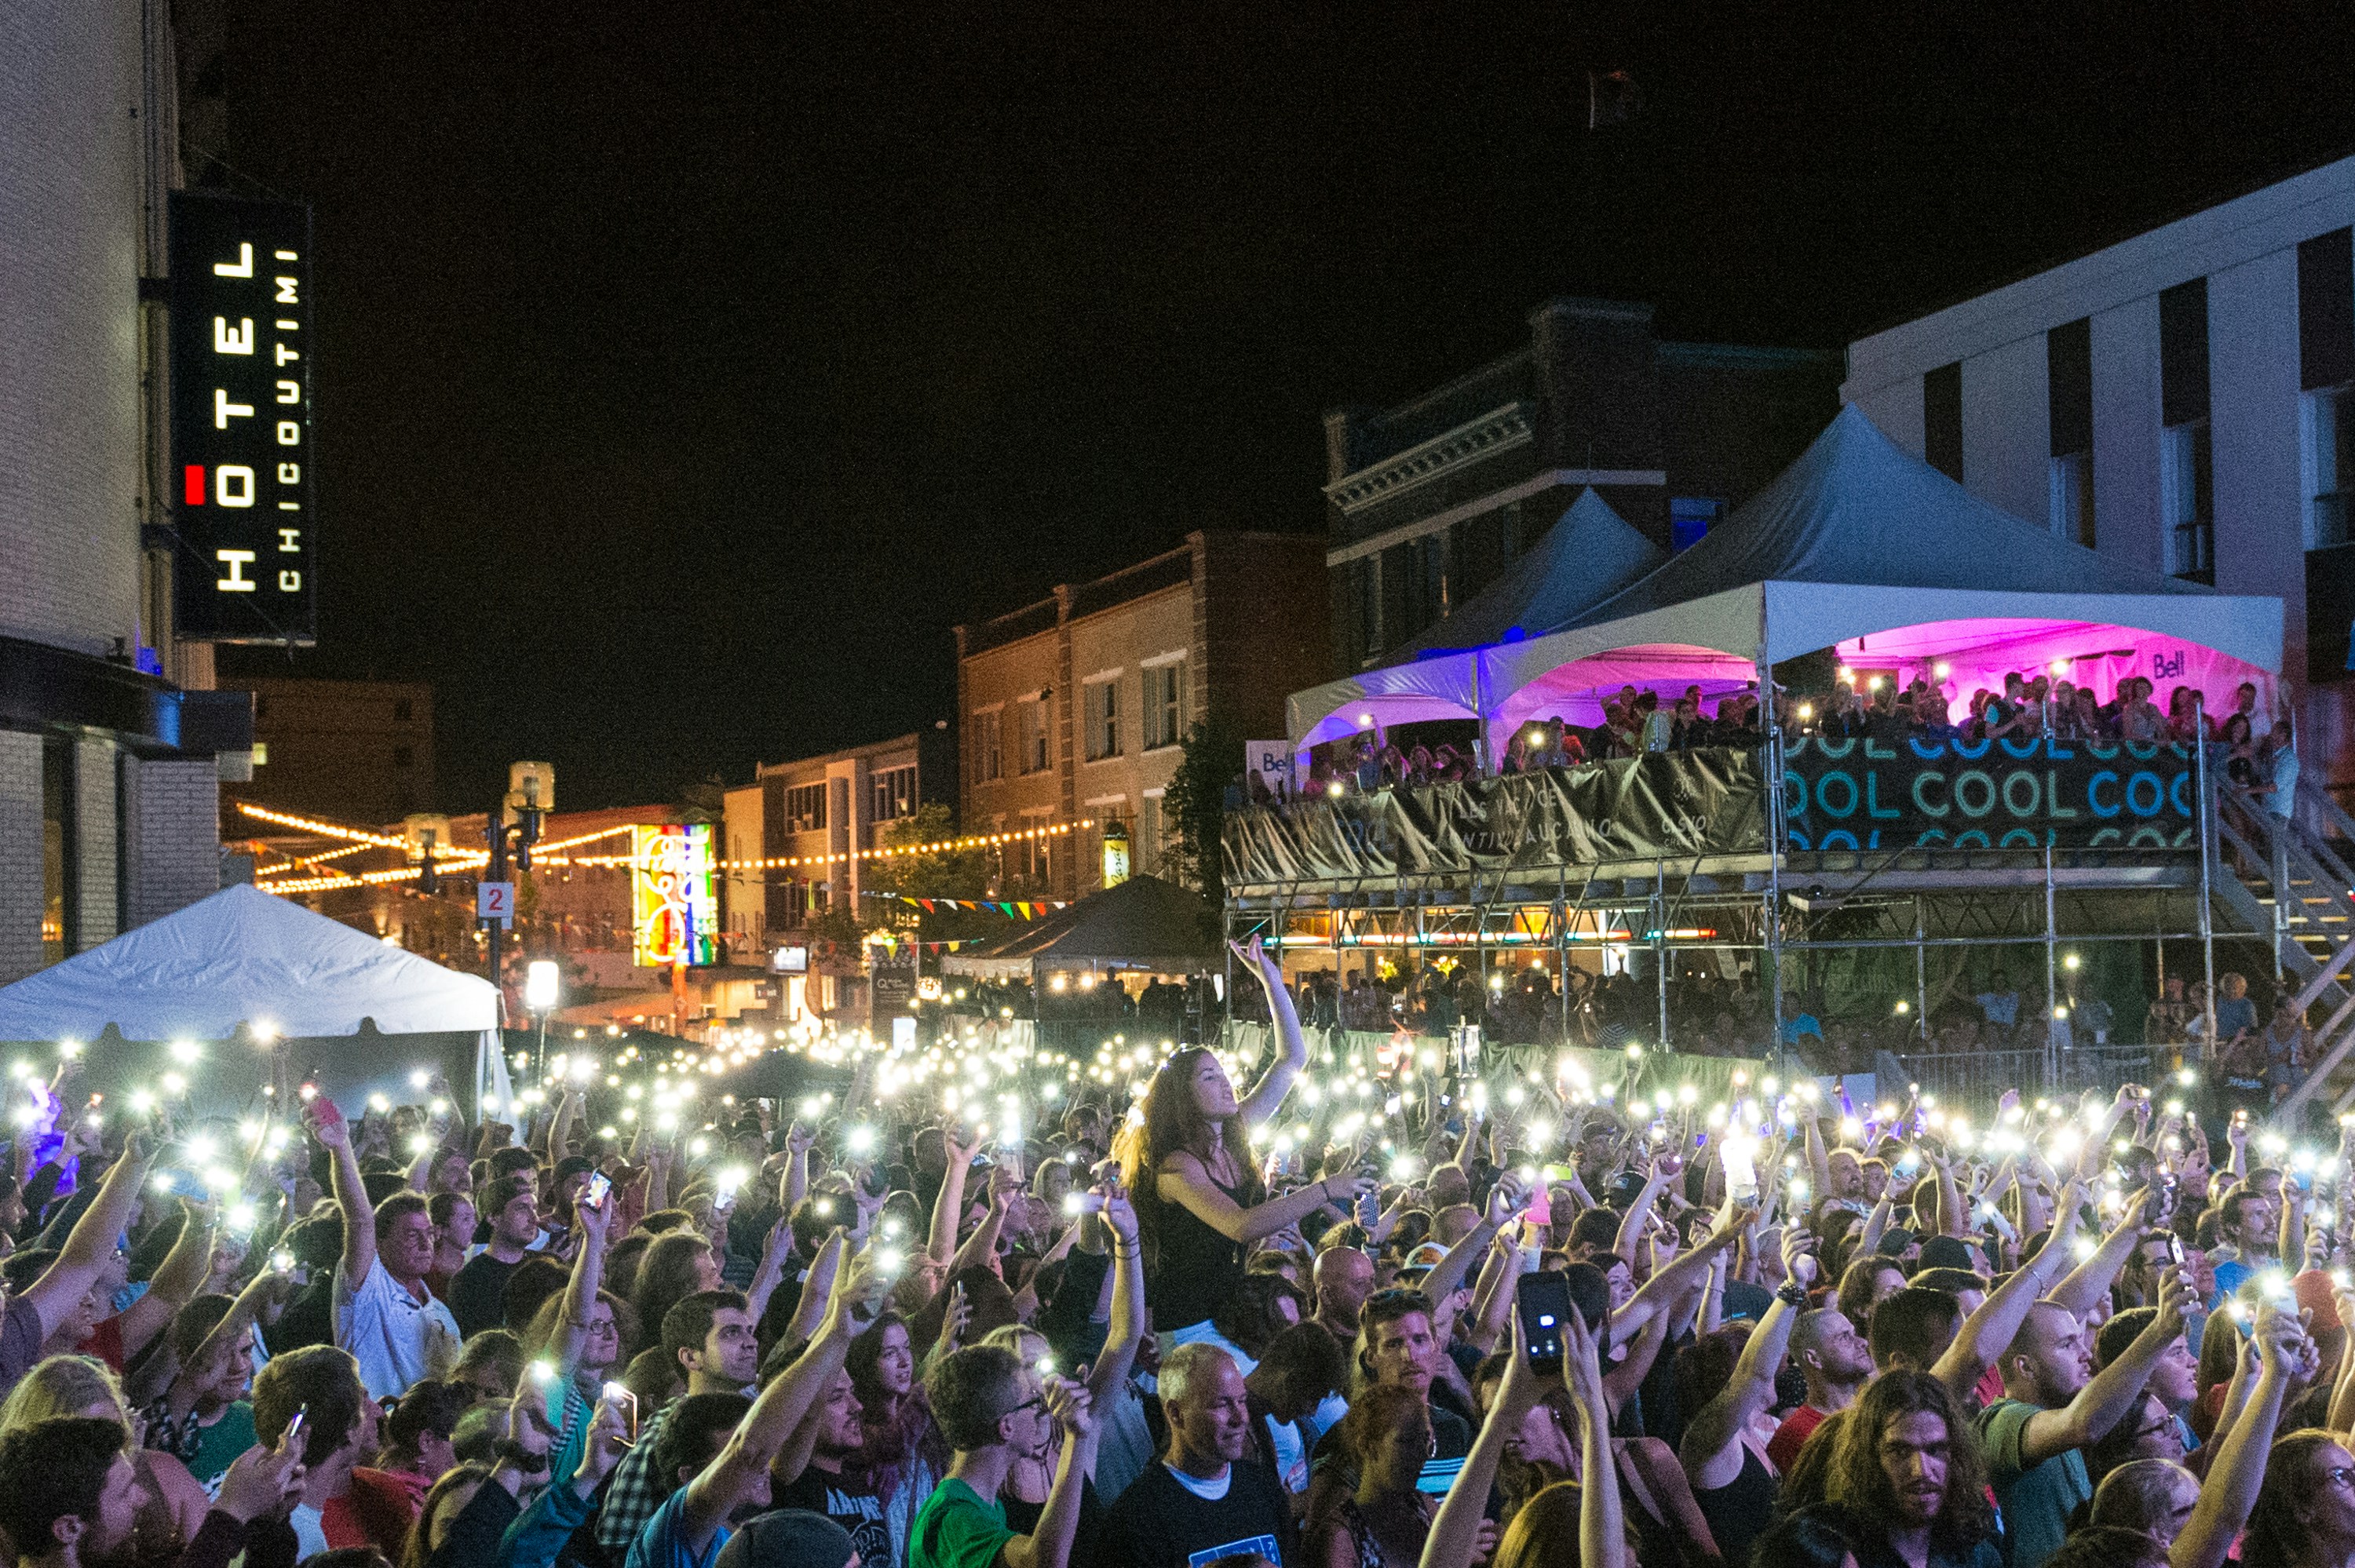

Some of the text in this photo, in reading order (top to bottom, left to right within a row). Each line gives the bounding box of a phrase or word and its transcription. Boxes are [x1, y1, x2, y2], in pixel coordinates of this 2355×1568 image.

[276, 250, 301, 592] CHICOUTIMI
[2153, 651, 2185, 679] Bell
[1264, 753, 1291, 772] Be
[1912, 770, 2077, 818] COOL
[488, 888, 503, 911] 2
